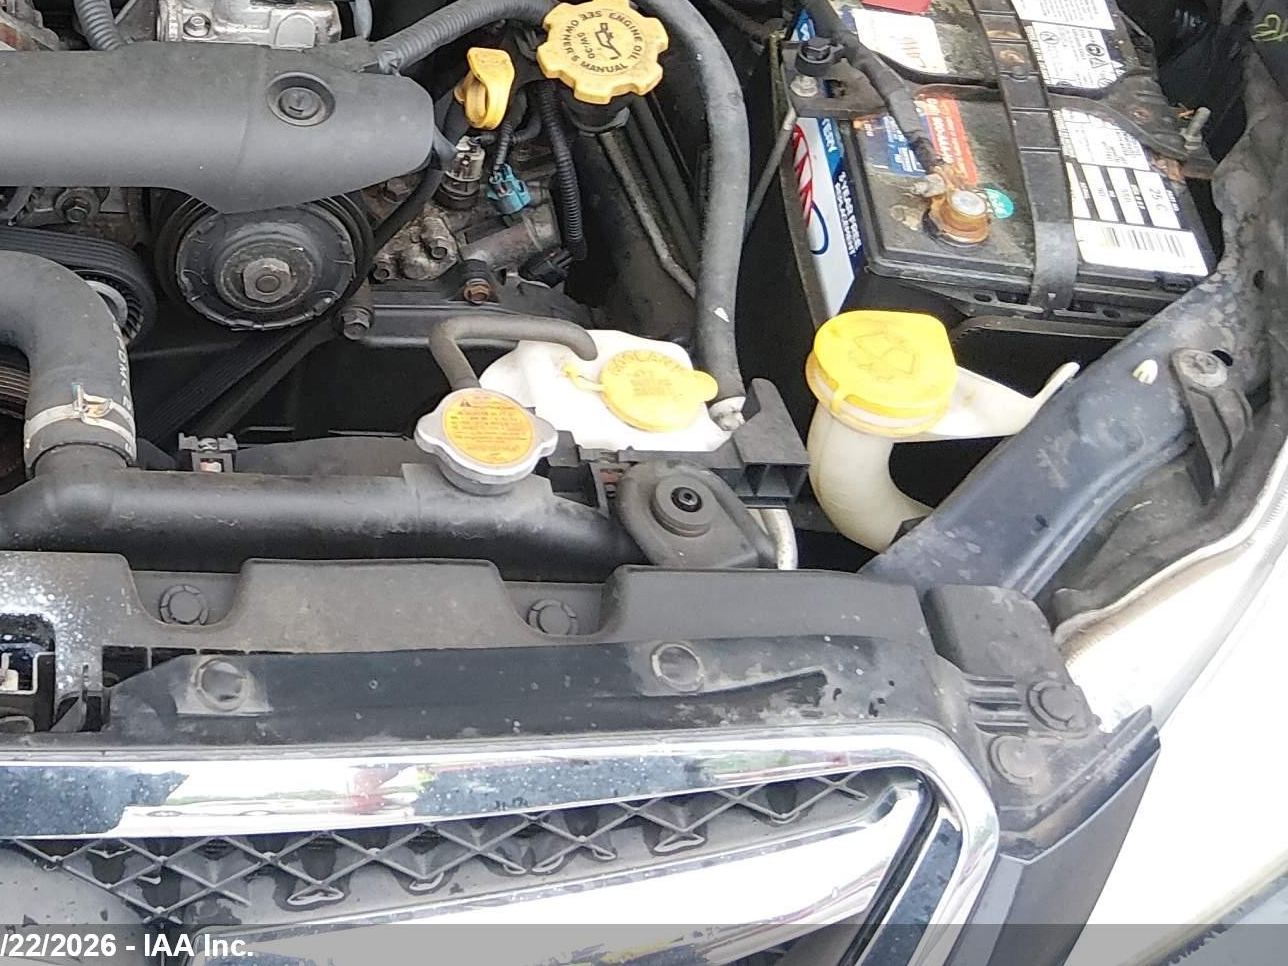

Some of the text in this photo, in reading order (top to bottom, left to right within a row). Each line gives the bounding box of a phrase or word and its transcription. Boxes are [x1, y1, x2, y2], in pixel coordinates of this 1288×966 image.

[579, 10, 602, 21] SEE
[609, 12, 643, 60] ENGINE OIL
[580, 60, 629, 73] MANUAL
